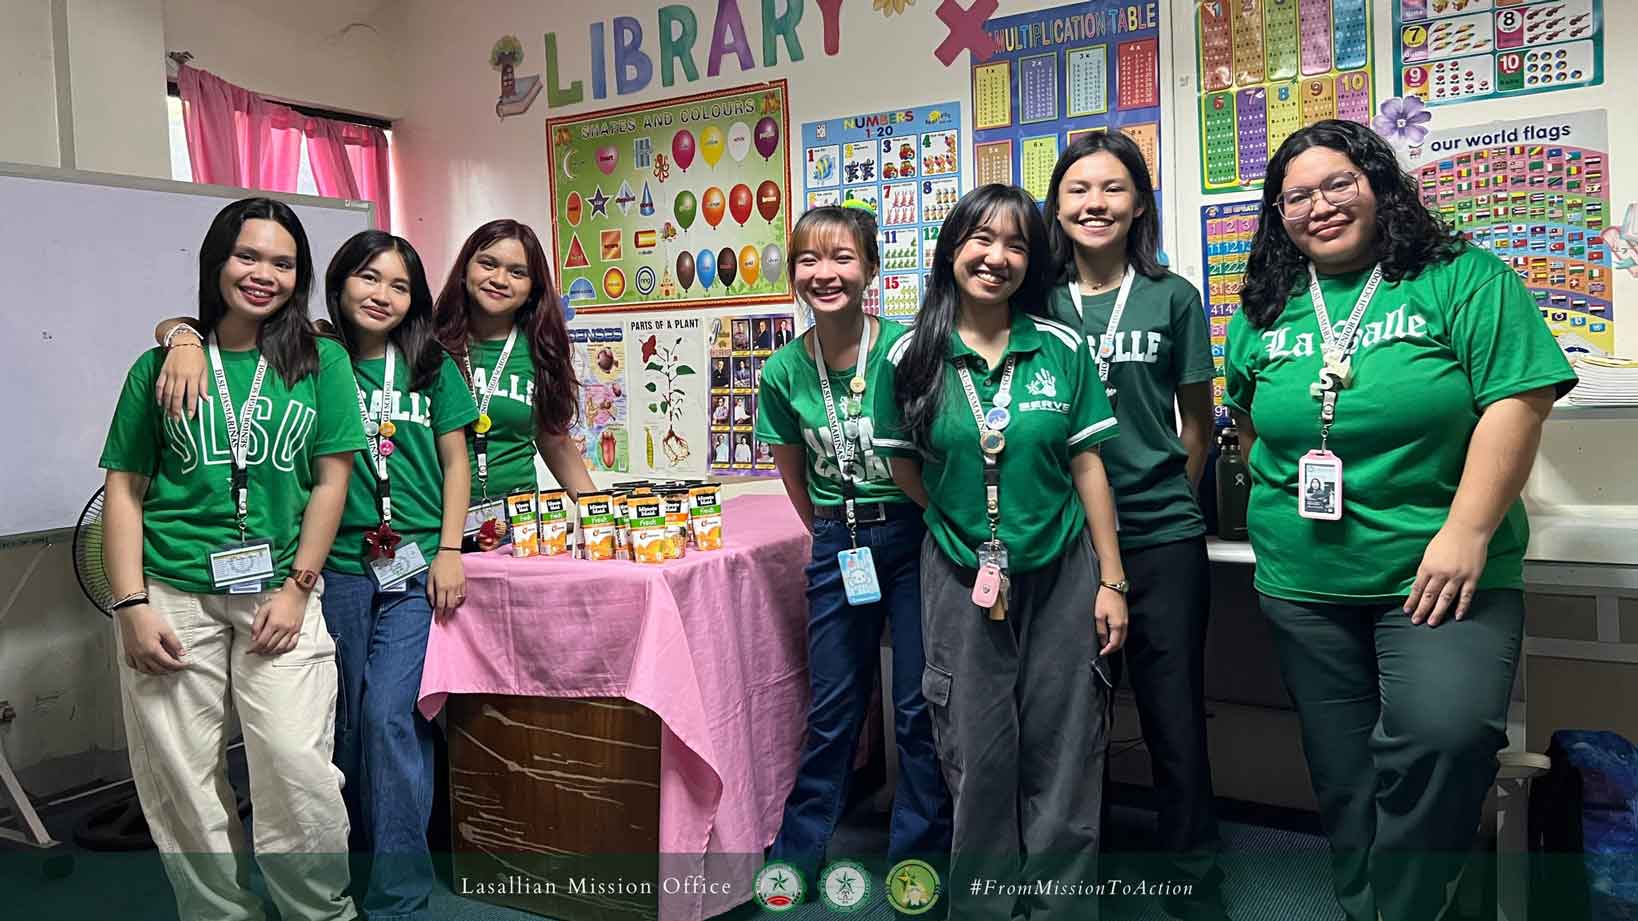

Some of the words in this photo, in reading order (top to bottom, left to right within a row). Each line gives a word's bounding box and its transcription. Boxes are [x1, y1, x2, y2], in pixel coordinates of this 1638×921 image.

[1503, 11, 1515, 26] 8
[992, 11, 1106, 54] MULTIPLICATION
[1108, 3, 1156, 34] TABLE
[1409, 27, 1420, 42] 7
[544, 0, 843, 109] LIBRARY
[1500, 54, 1519, 71] 10
[1343, 74, 1364, 91] 10
[1409, 67, 1421, 83] 9
[1278, 86, 1290, 101] 8
[1311, 80, 1323, 96] 9
[643, 112, 674, 129] AND
[680, 98, 755, 123] COLOURS
[843, 110, 914, 129] NUMBERS
[922, 134, 931, 148] 4
[1430, 138, 1461, 152] our
[1465, 128, 1518, 147] world
[1523, 124, 1571, 141] flags
[882, 140, 892, 153] 3
[807, 149, 814, 162] 1
[883, 185, 892, 199] 7
[923, 181, 932, 195] 8
[923, 226, 939, 241] 12
[1225, 222, 1235, 233] 2
[1241, 220, 1250, 231] 3
[884, 230, 897, 244] 11
[1224, 242, 1238, 253] 12
[1209, 264, 1223, 275] 21
[1224, 263, 1239, 273] 22
[884, 276, 900, 290] 15
[1224, 283, 1239, 294] 32
[630, 321, 653, 331] PARTS
[655, 320, 663, 329] OF
[667, 320, 673, 329] A
[674, 318, 699, 329] PLANT
[1261, 325, 1315, 360] La
[1018, 399, 1070, 414] SERVE
[1214, 406, 1229, 417] 91
[240, 417, 250, 448] SENIOR
